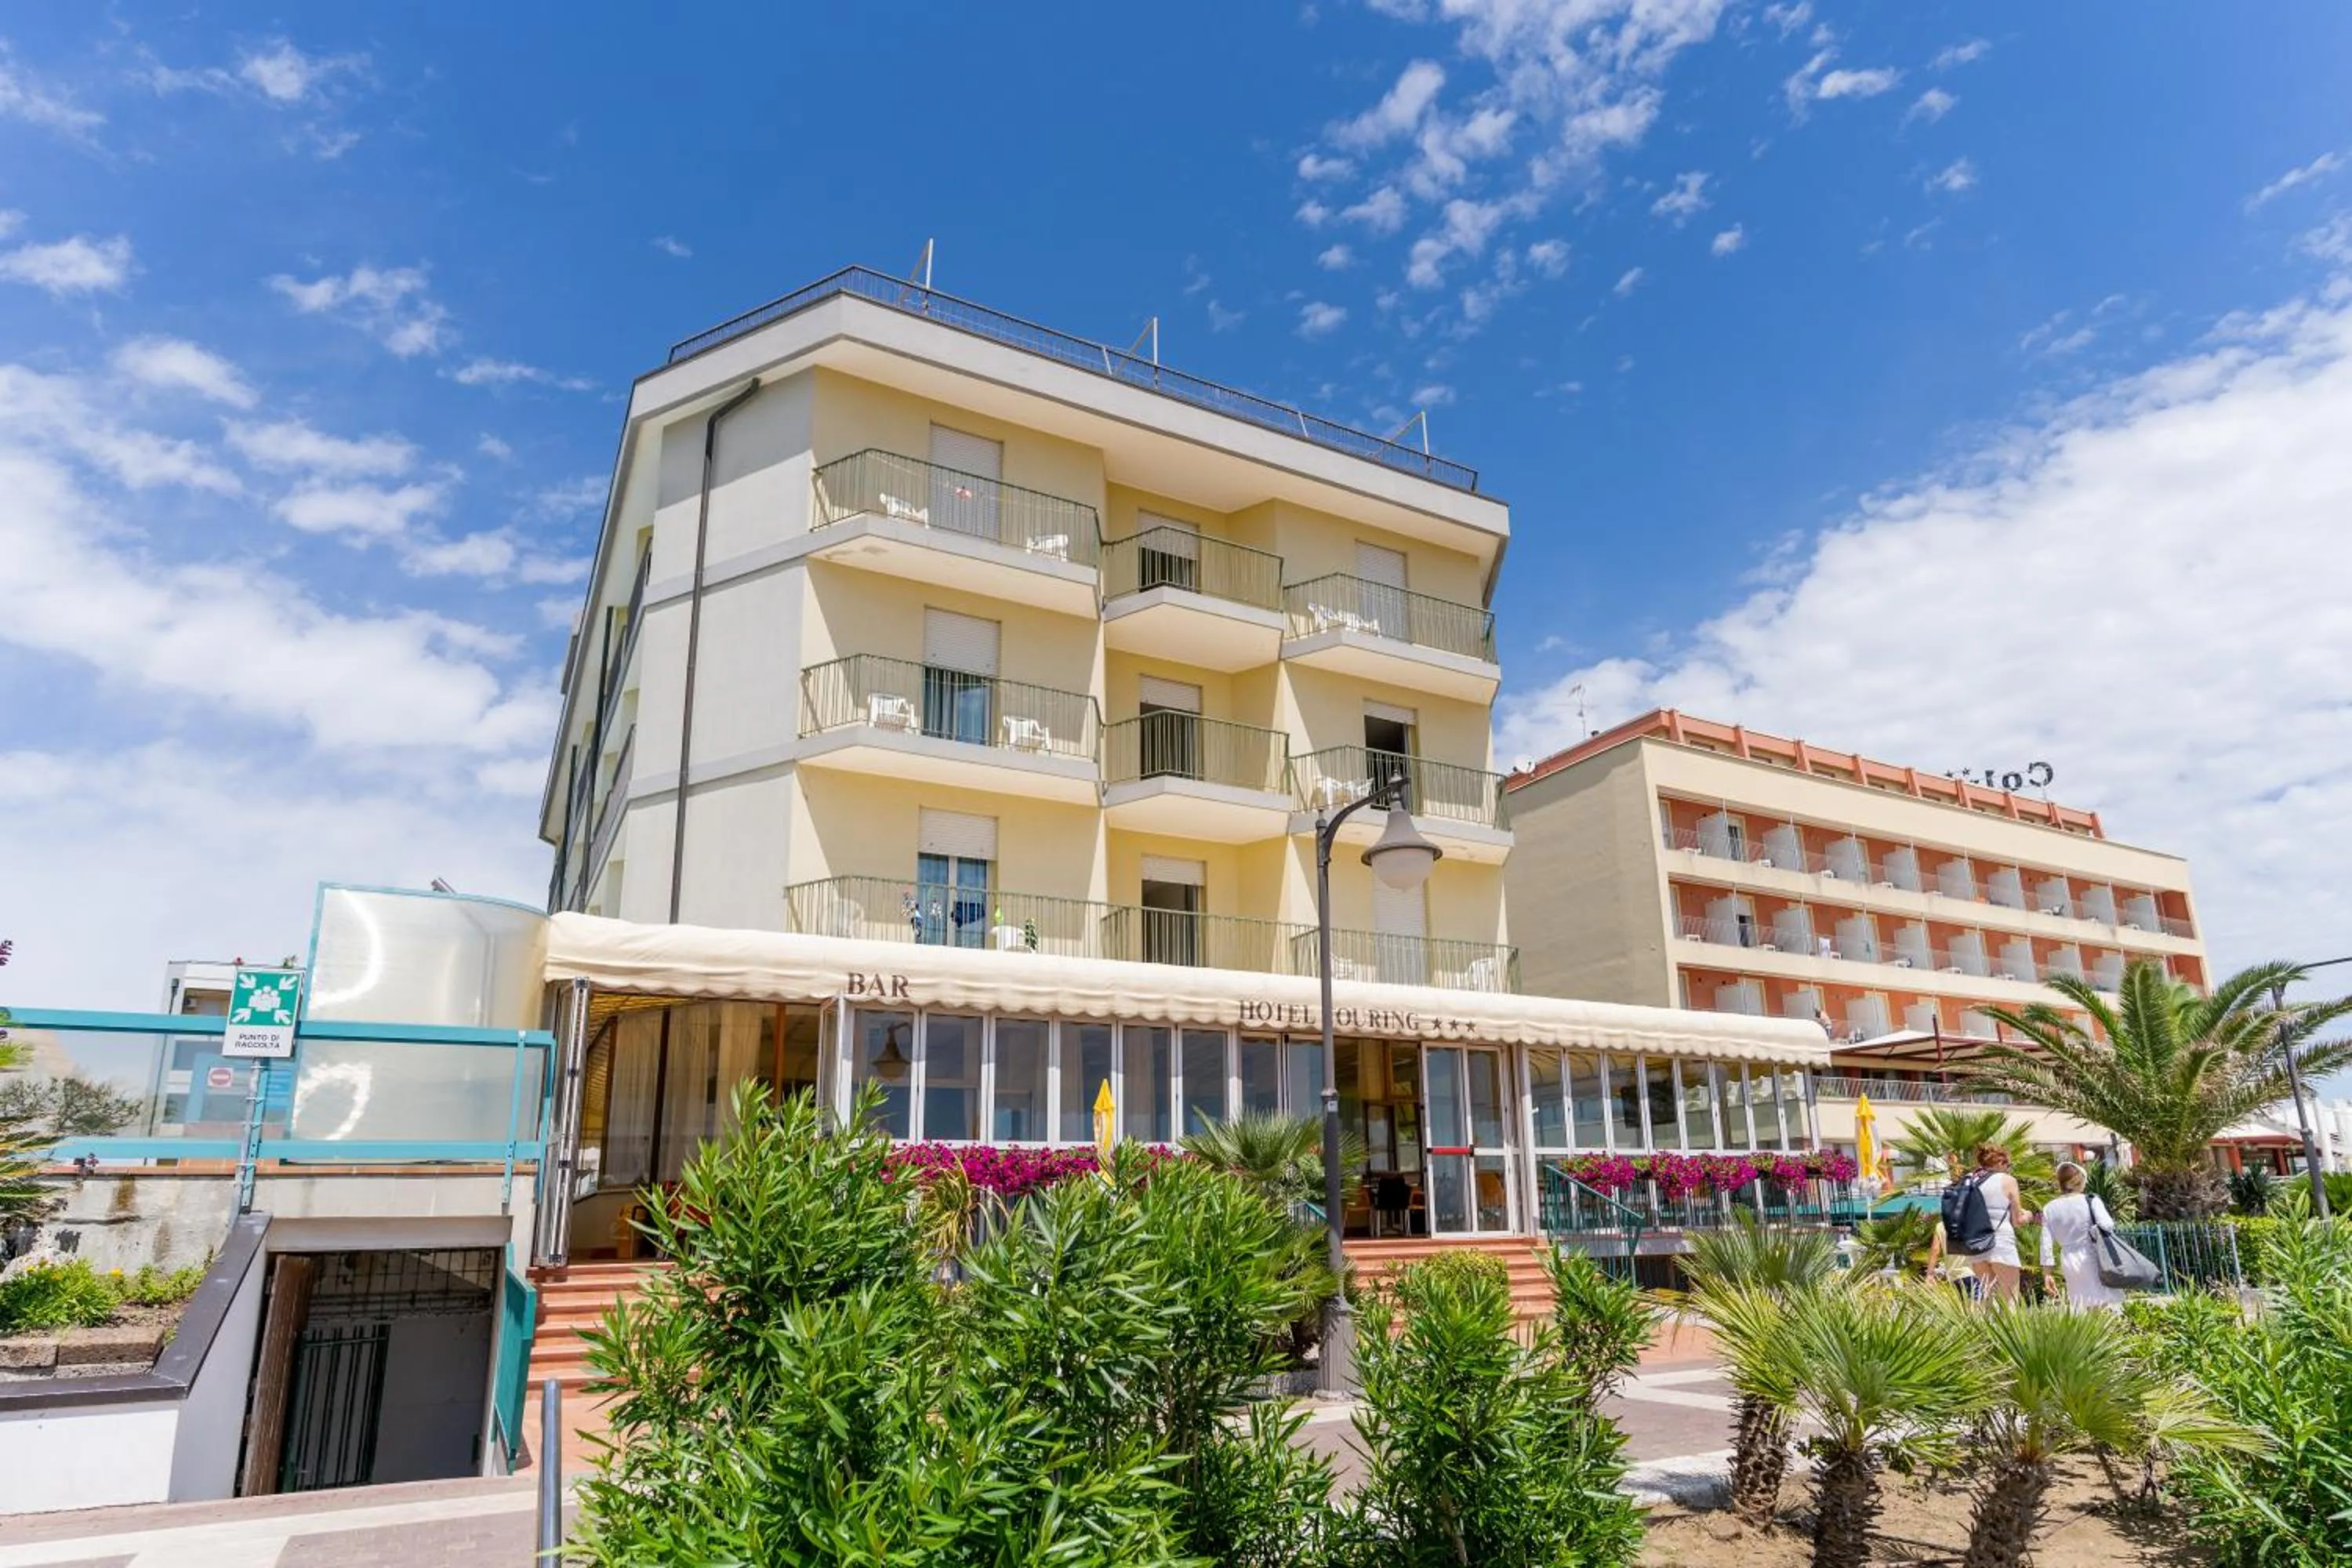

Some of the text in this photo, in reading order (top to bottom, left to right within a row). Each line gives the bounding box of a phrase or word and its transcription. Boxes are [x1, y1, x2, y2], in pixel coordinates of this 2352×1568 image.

[848, 972, 909, 997] BAR
[1240, 1000, 1419, 1031] HOTEL OURING
